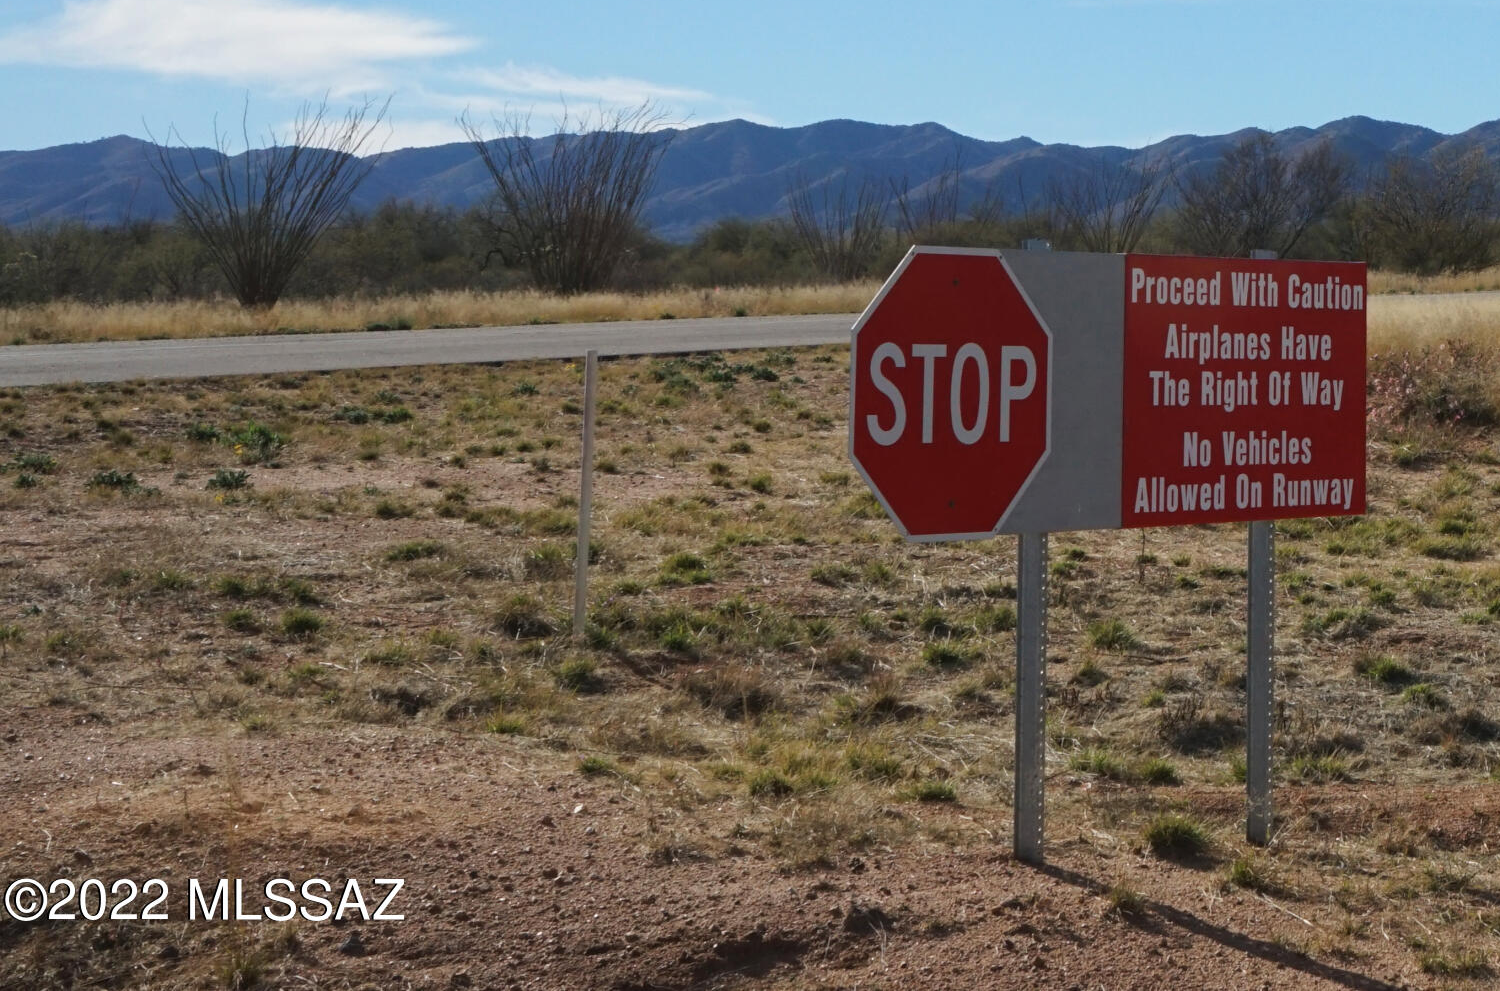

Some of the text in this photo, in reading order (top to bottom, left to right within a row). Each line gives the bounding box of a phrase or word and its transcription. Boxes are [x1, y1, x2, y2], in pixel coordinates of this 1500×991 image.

[1131, 267, 1363, 310] Proceed With Caution
[1165, 323, 1332, 365] Airplanes Have
[866, 341, 1037, 446] STOP
[1149, 370, 1344, 413] The Right Of Way
[1183, 430, 1312, 467] No Vehicles
[1134, 473, 1354, 513] Allowed On Runway
